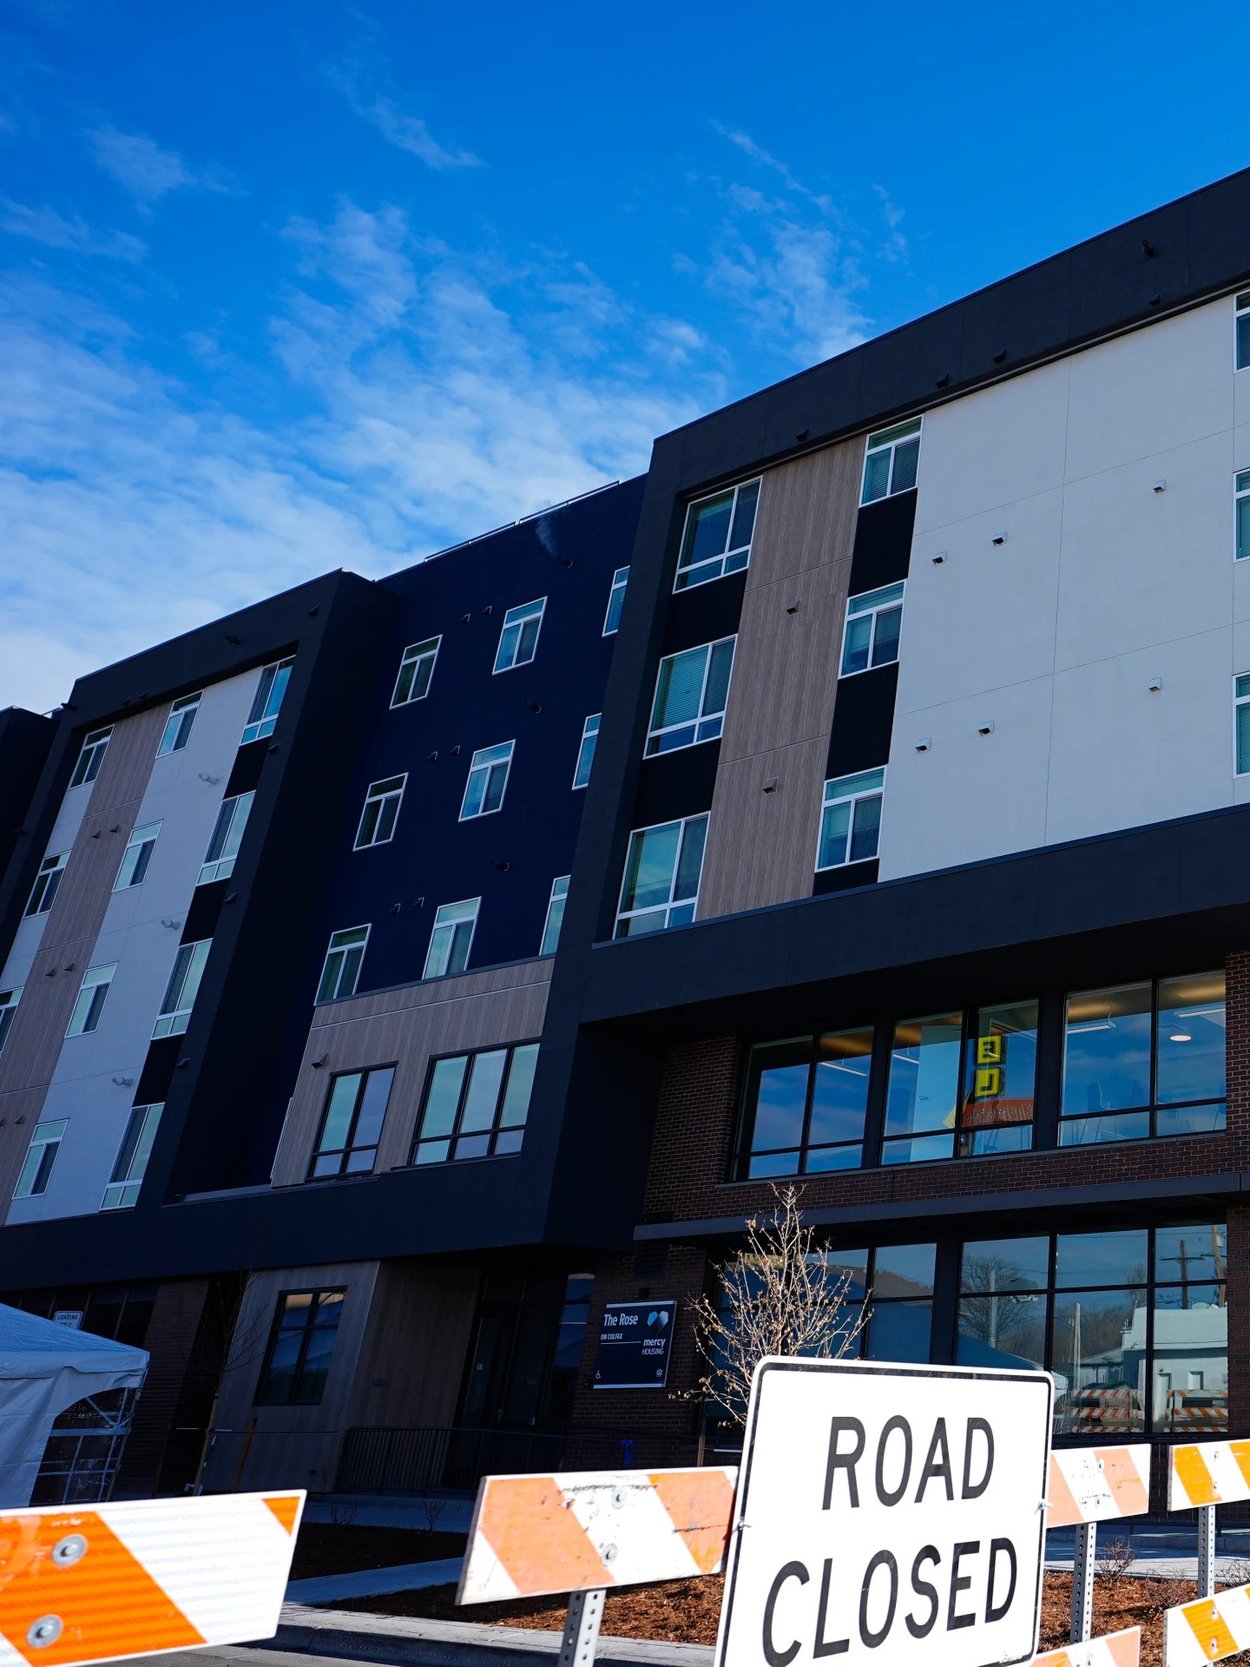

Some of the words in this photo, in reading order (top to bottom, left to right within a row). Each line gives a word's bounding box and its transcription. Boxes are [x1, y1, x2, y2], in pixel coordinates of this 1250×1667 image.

[603, 1313, 617, 1327] The
[618, 1313, 639, 1325] Rose
[607, 1332, 624, 1340] COLFAX
[643, 1338, 666, 1347] mercy
[641, 1347, 664, 1355] HOUSING
[822, 1415, 995, 1511] ROAD
[762, 1537, 1018, 1667] CLOSED
